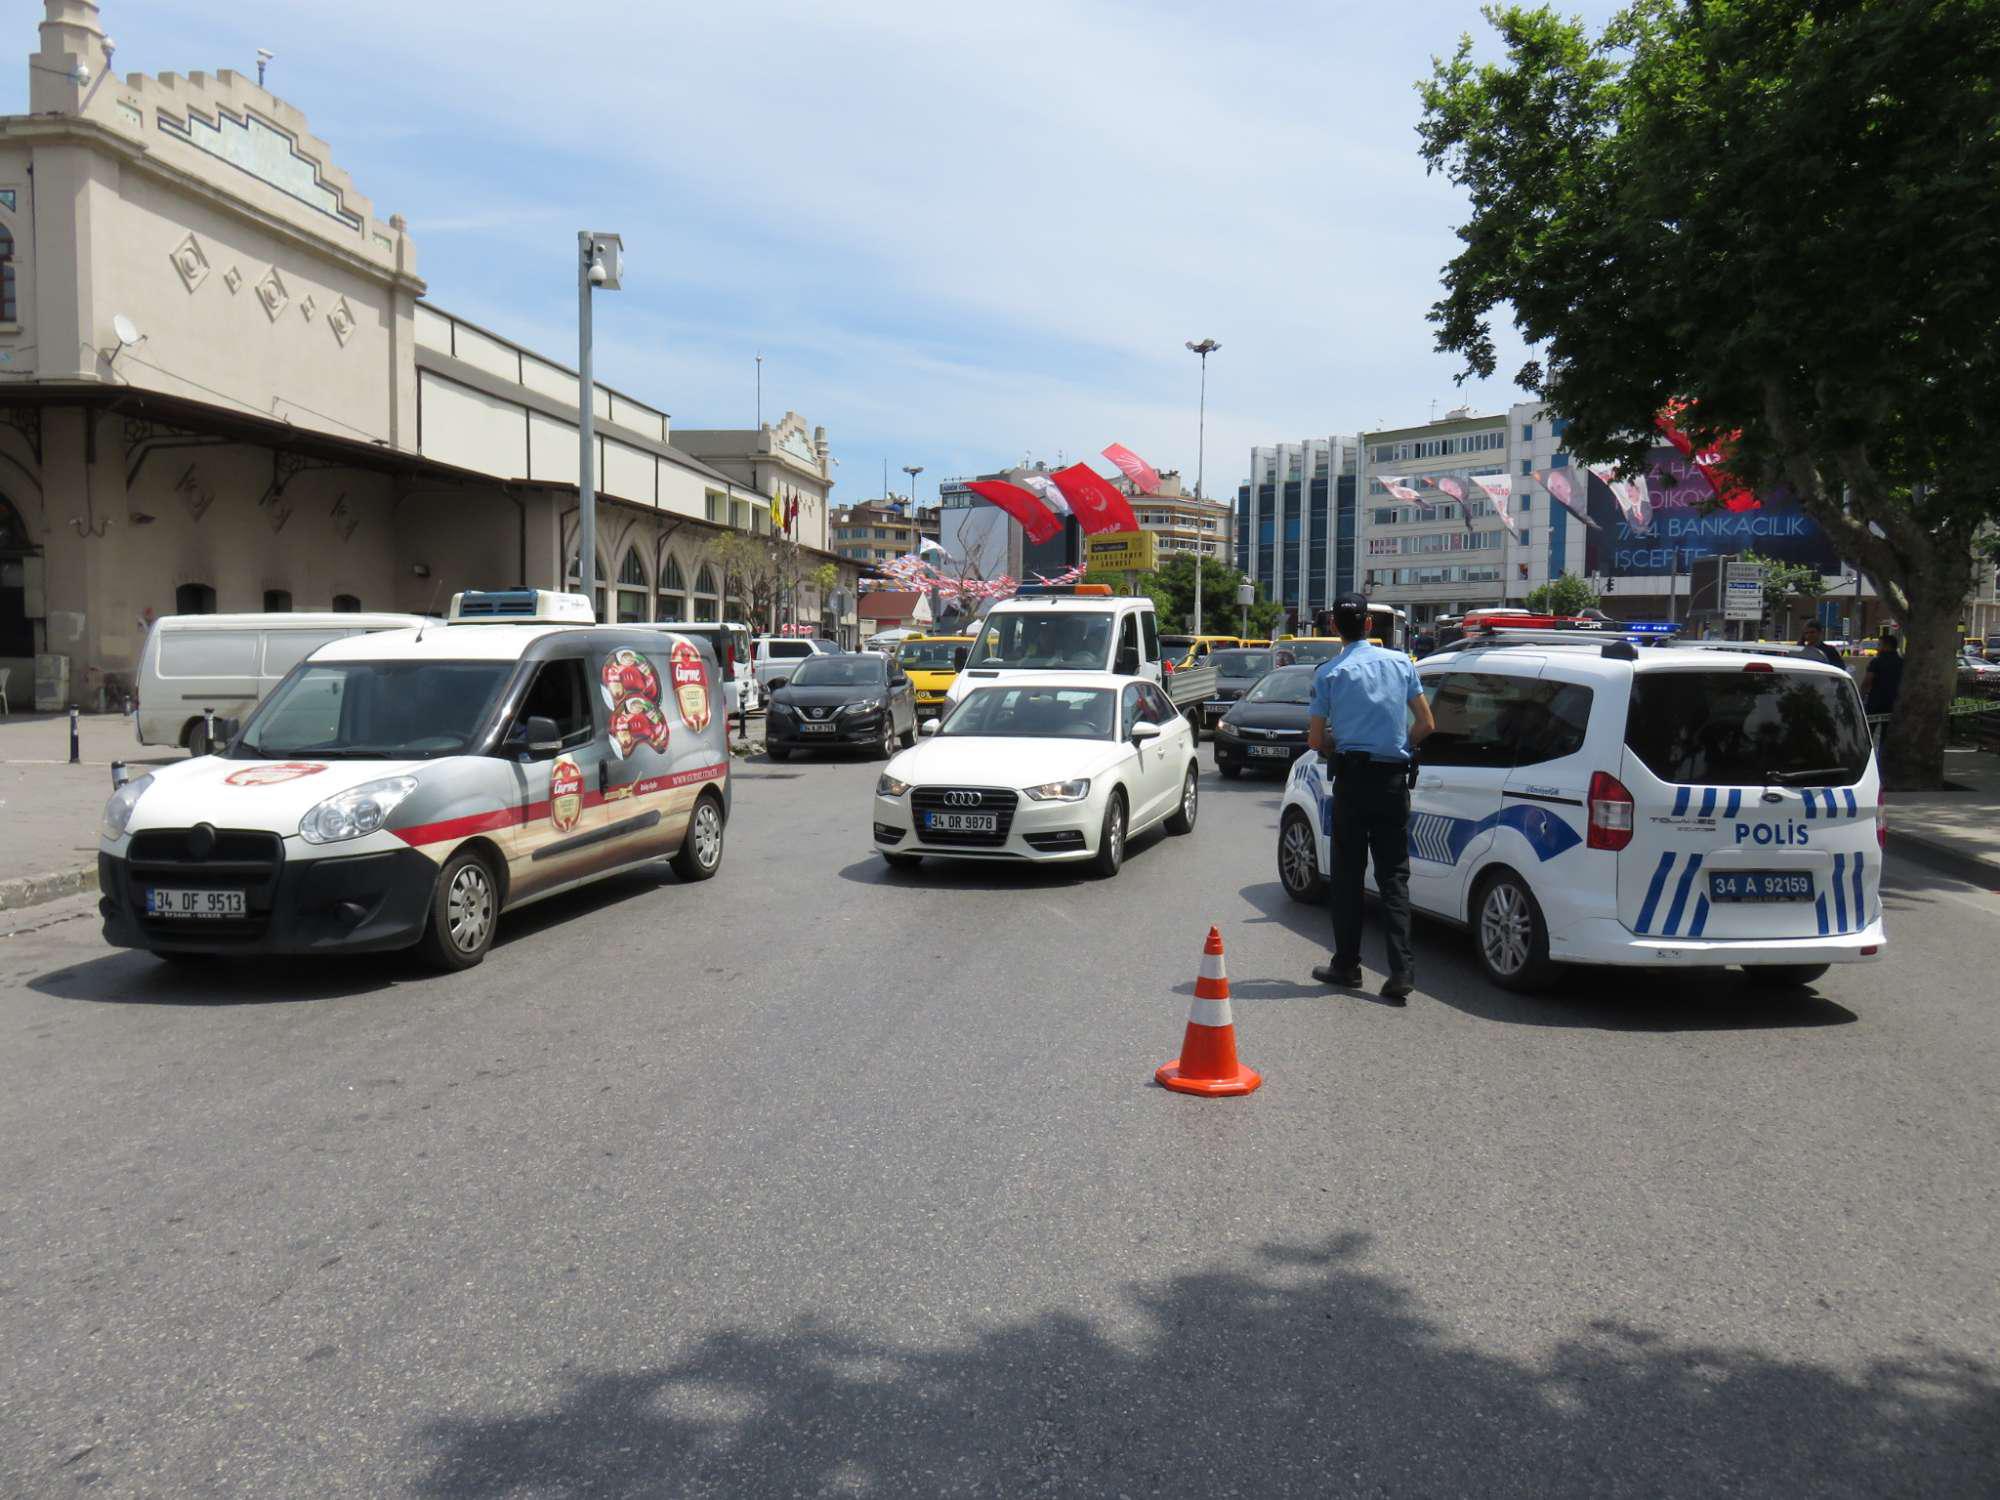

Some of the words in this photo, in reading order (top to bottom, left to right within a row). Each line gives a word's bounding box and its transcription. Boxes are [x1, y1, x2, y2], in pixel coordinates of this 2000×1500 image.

[1668, 516, 1805, 537] BANKACILIK
[931, 815, 944, 827] 34
[1735, 818, 1809, 846] POLİS
[1715, 878, 1737, 894] 34
[1745, 878, 1757, 893] A
[1764, 877, 1809, 893] 92159
[156, 891, 173, 910] 34
[207, 893, 242, 911] 9513
